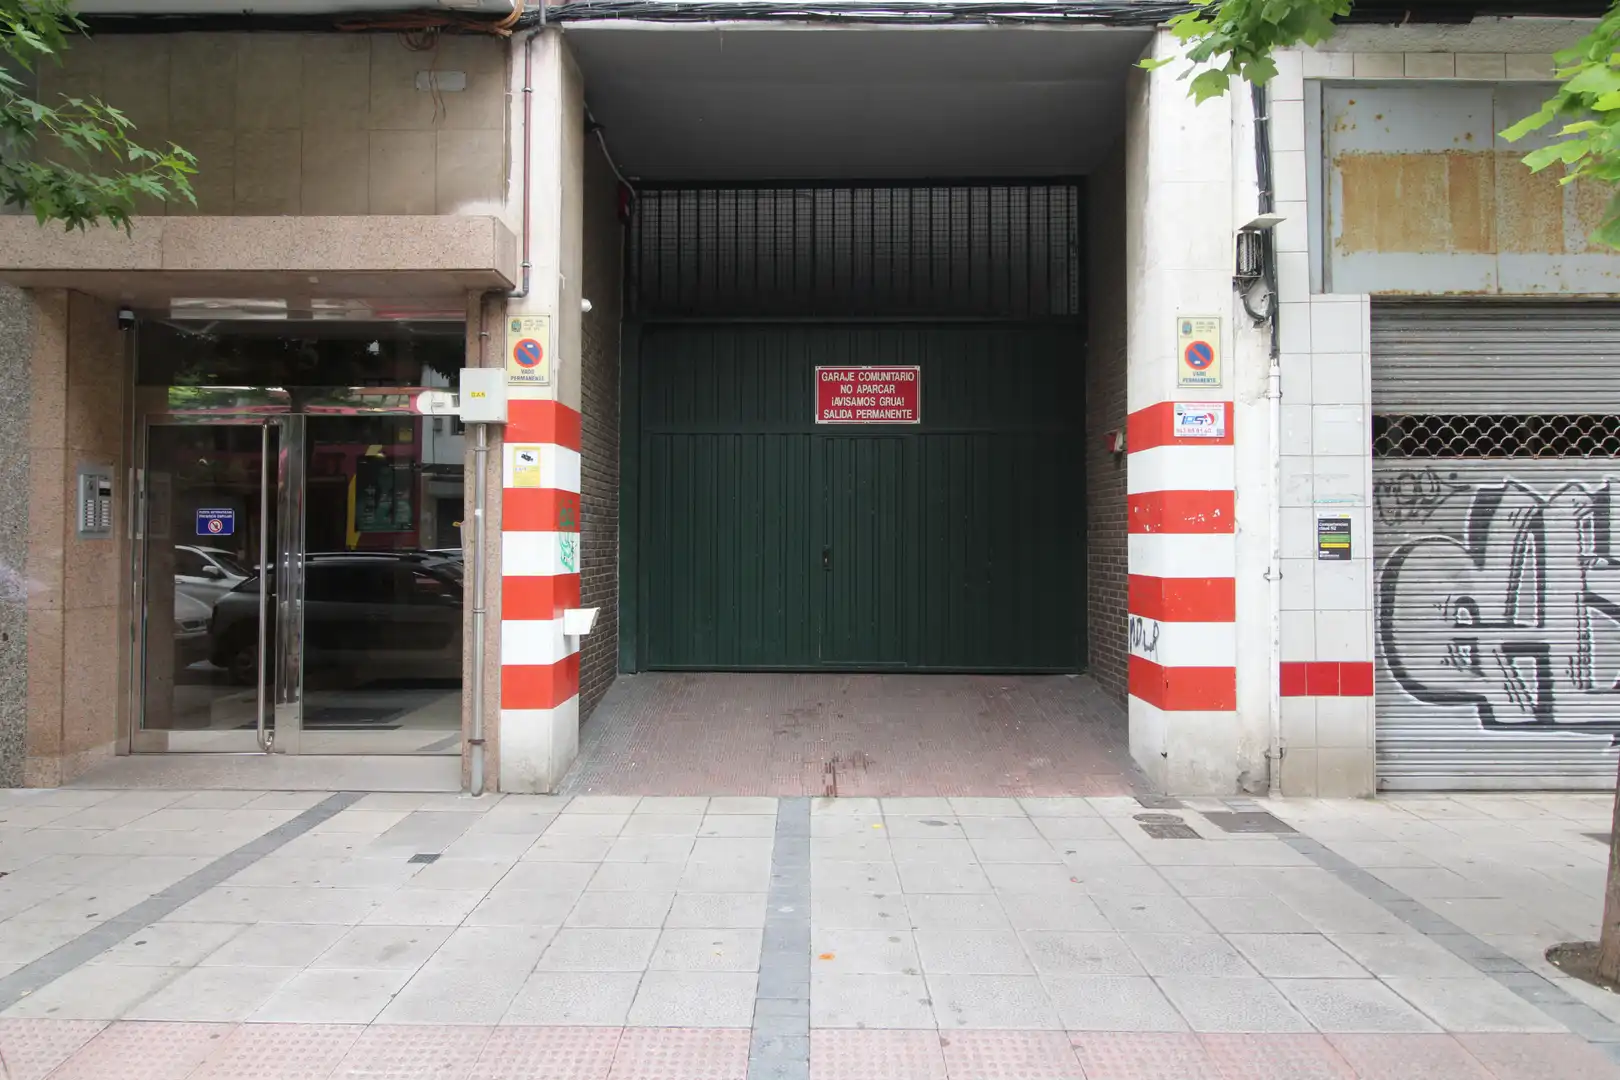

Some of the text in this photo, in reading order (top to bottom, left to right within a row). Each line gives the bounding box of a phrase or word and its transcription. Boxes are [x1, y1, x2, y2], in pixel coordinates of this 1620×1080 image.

[821, 371, 915, 382] GARAJE COMUNITARIO
[840, 384, 896, 394] NO APARCAR
[831, 396, 905, 407] ¡AVISAMOS GRUA!
[823, 409, 913, 419] SALIDA PERMANENTE
